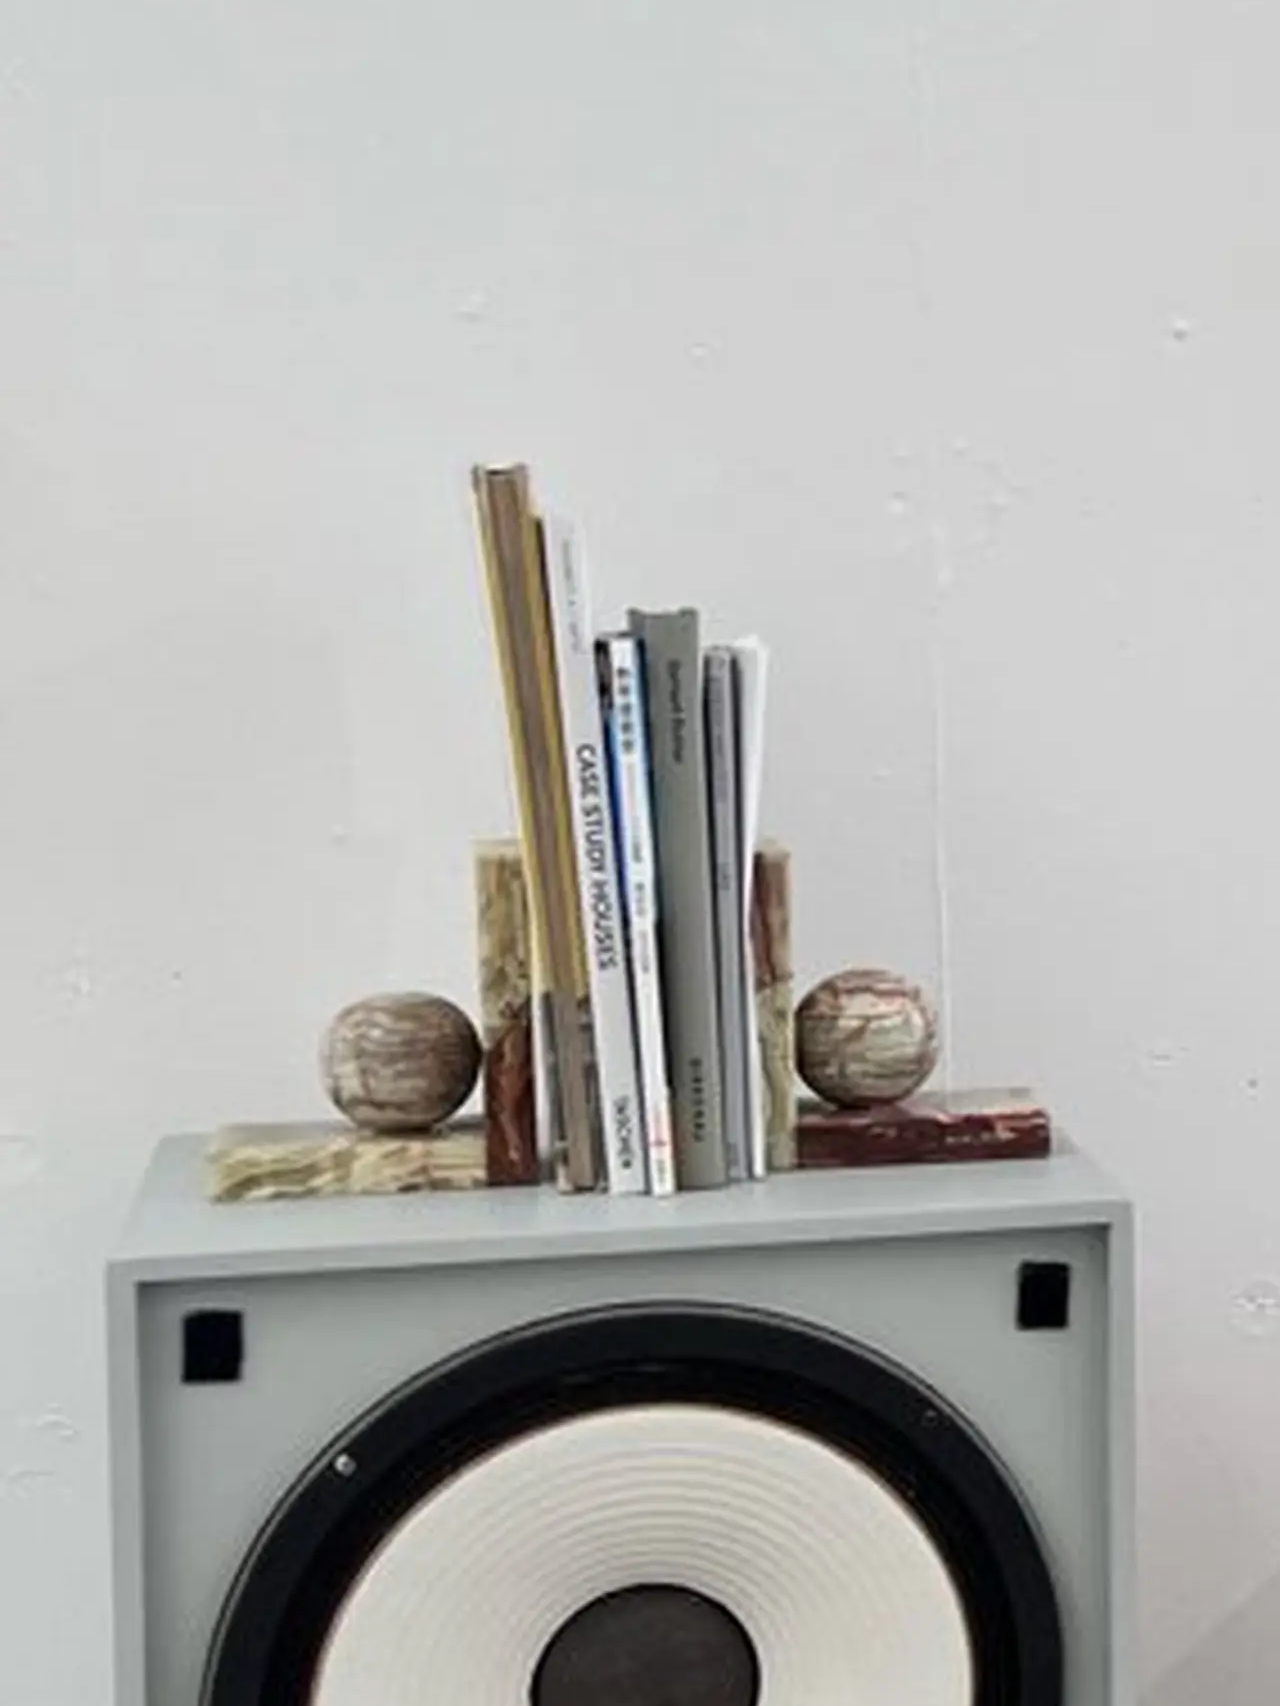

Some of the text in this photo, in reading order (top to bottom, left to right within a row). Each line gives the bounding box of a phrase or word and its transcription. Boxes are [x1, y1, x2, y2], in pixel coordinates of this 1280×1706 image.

[576, 744, 617, 971] CASE STUDY HOUSES
